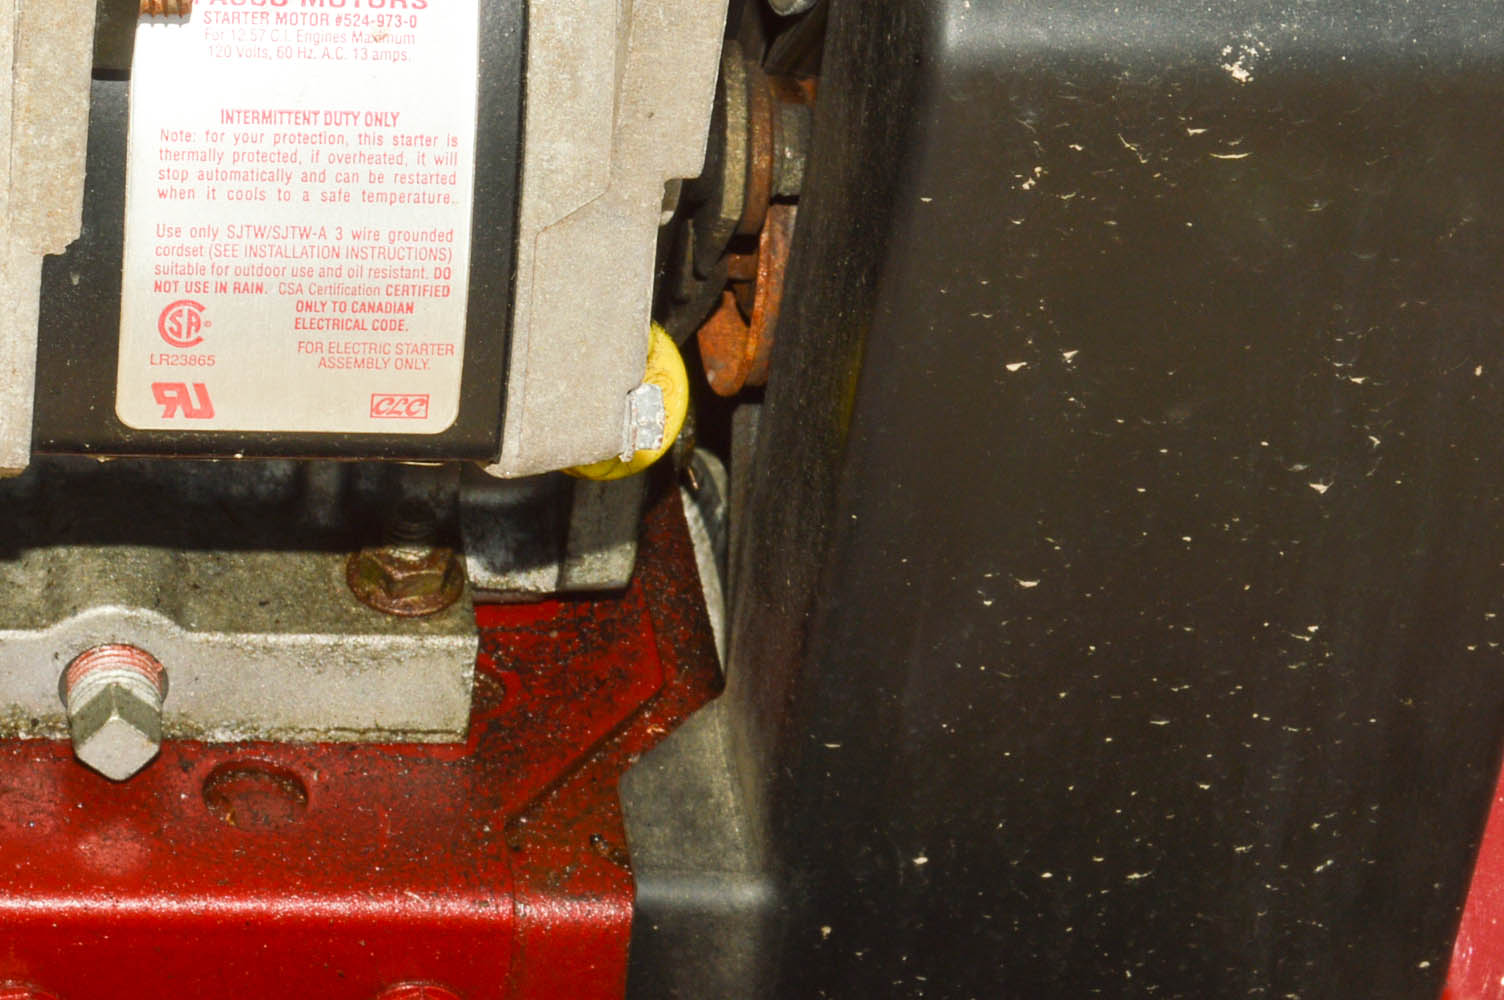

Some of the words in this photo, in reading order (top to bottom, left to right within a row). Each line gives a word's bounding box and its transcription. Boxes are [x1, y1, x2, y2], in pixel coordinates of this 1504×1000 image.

[203, 11, 269, 25] STARTER
[275, 12, 330, 26] MOTOR
[335, 13, 417, 28] #524-973-0
[297, 29, 346, 45] Engines
[208, 44, 231, 57] 120
[277, 46, 292, 59] 60
[353, 48, 368, 60] 13
[221, 109, 320, 125] INTERMITTENT
[324, 111, 360, 126] DUTY
[365, 112, 400, 127] ONLY
[160, 129, 195, 143] Note:
[205, 129, 224, 142] for
[233, 132, 264, 145] your
[273, 132, 349, 146] protection,
[358, 132, 383, 146] this
[392, 133, 438, 146] starter
[447, 134, 458, 147] is
[159, 149, 224, 165] thermally
[233, 150, 302, 165] protected,
[311, 149, 319, 163] if
[328, 151, 408, 167] overheated,
[417, 152, 426, 165] it
[434, 152, 458, 166] will
[159, 168, 189, 183] stop
[197, 168, 292, 185] automatically
[301, 169, 326, 183] and
[336, 171, 359, 183] can
[369, 171, 384, 184] be
[394, 172, 456, 185] restarted
[157, 186, 195, 199] when
[207, 186, 216, 200] it
[227, 187, 266, 201] cools
[278, 188, 291, 201] to
[303, 191, 309, 201] a
[321, 188, 350, 202] safe
[156, 224, 182, 237] Use
[190, 224, 219, 241] only
[227, 224, 327, 240] SJTW/SJTW-A
[336, 227, 343, 240] 3
[352, 227, 380, 241] wire
[388, 228, 454, 244] grounded
[155, 244, 203, 256] cordset
[209, 243, 239, 260] (SEE
[245, 244, 340, 259] INSTALLATION
[346, 246, 452, 263] INSTRUCTIONS)
[154, 262, 206, 276] suitable
[211, 263, 229, 276] for
[234, 263, 287, 277] outdoor
[292, 266, 314, 278] use
[319, 264, 342, 278] and
[348, 265, 363, 278] oil
[434, 267, 451, 280] DO
[154, 281, 179, 293] NOT
[185, 281, 209, 294] USE
[215, 282, 227, 294] IN
[233, 282, 268, 294] RAIN.
[279, 282, 303, 295] CSA
[309, 282, 380, 297] Certification
[386, 284, 450, 297] CERTIFIED
[296, 300, 327, 313] ONLY
[332, 301, 346, 313] TO
[352, 301, 414, 314] CANADIAN
[295, 318, 368, 331] ELECTRICAL
[372, 319, 408, 332] CODE.
[298, 341, 324, 354] FOR
[328, 341, 391, 355] ELECTRIC
[396, 343, 454, 356] STARTER
[150, 353, 215, 367] LR23865
[318, 357, 391, 369] ASSEMBLY
[395, 358, 431, 370] ONLY.
